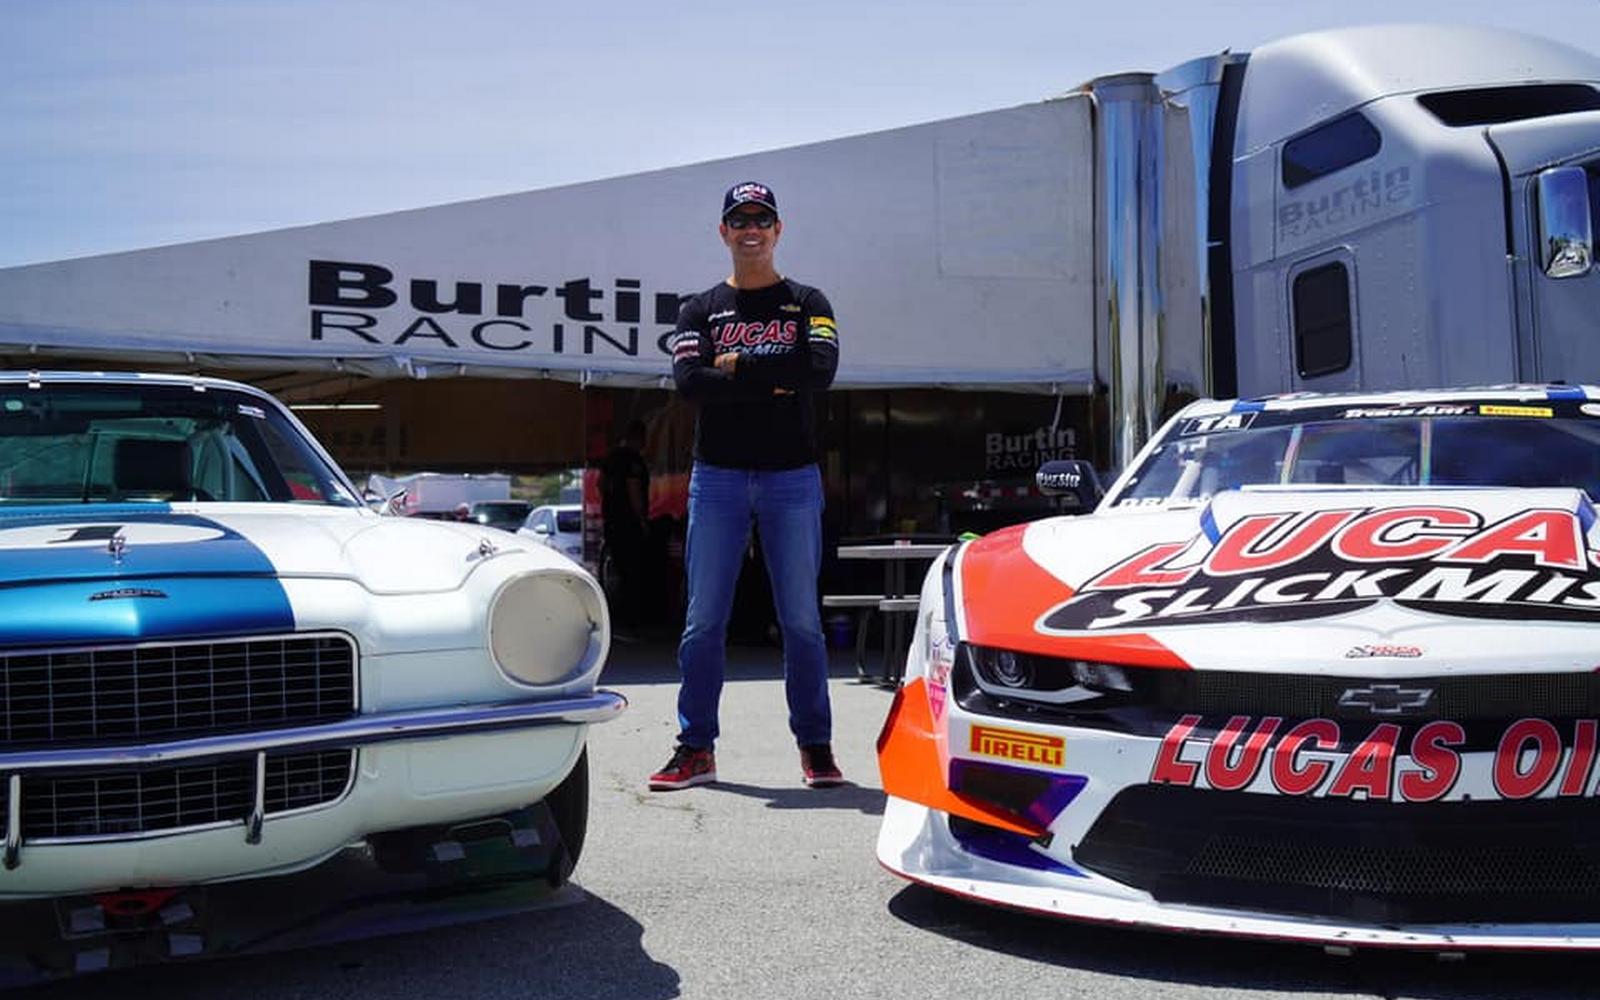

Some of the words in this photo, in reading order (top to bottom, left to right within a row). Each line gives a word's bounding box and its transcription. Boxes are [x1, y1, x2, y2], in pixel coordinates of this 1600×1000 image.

[1279, 166, 1410, 227] Burtin
[1280, 183, 1412, 243] RACING
[1195, 414, 1243, 432] TA
[1344, 408, 1416, 419] Trans
[985, 426, 1077, 454] Burtin
[1080, 505, 1600, 592] LUCA
[970, 724, 1065, 767] PIRELLI
[1149, 714, 1467, 803] LUCAS
[1494, 717, 1600, 801] OI
